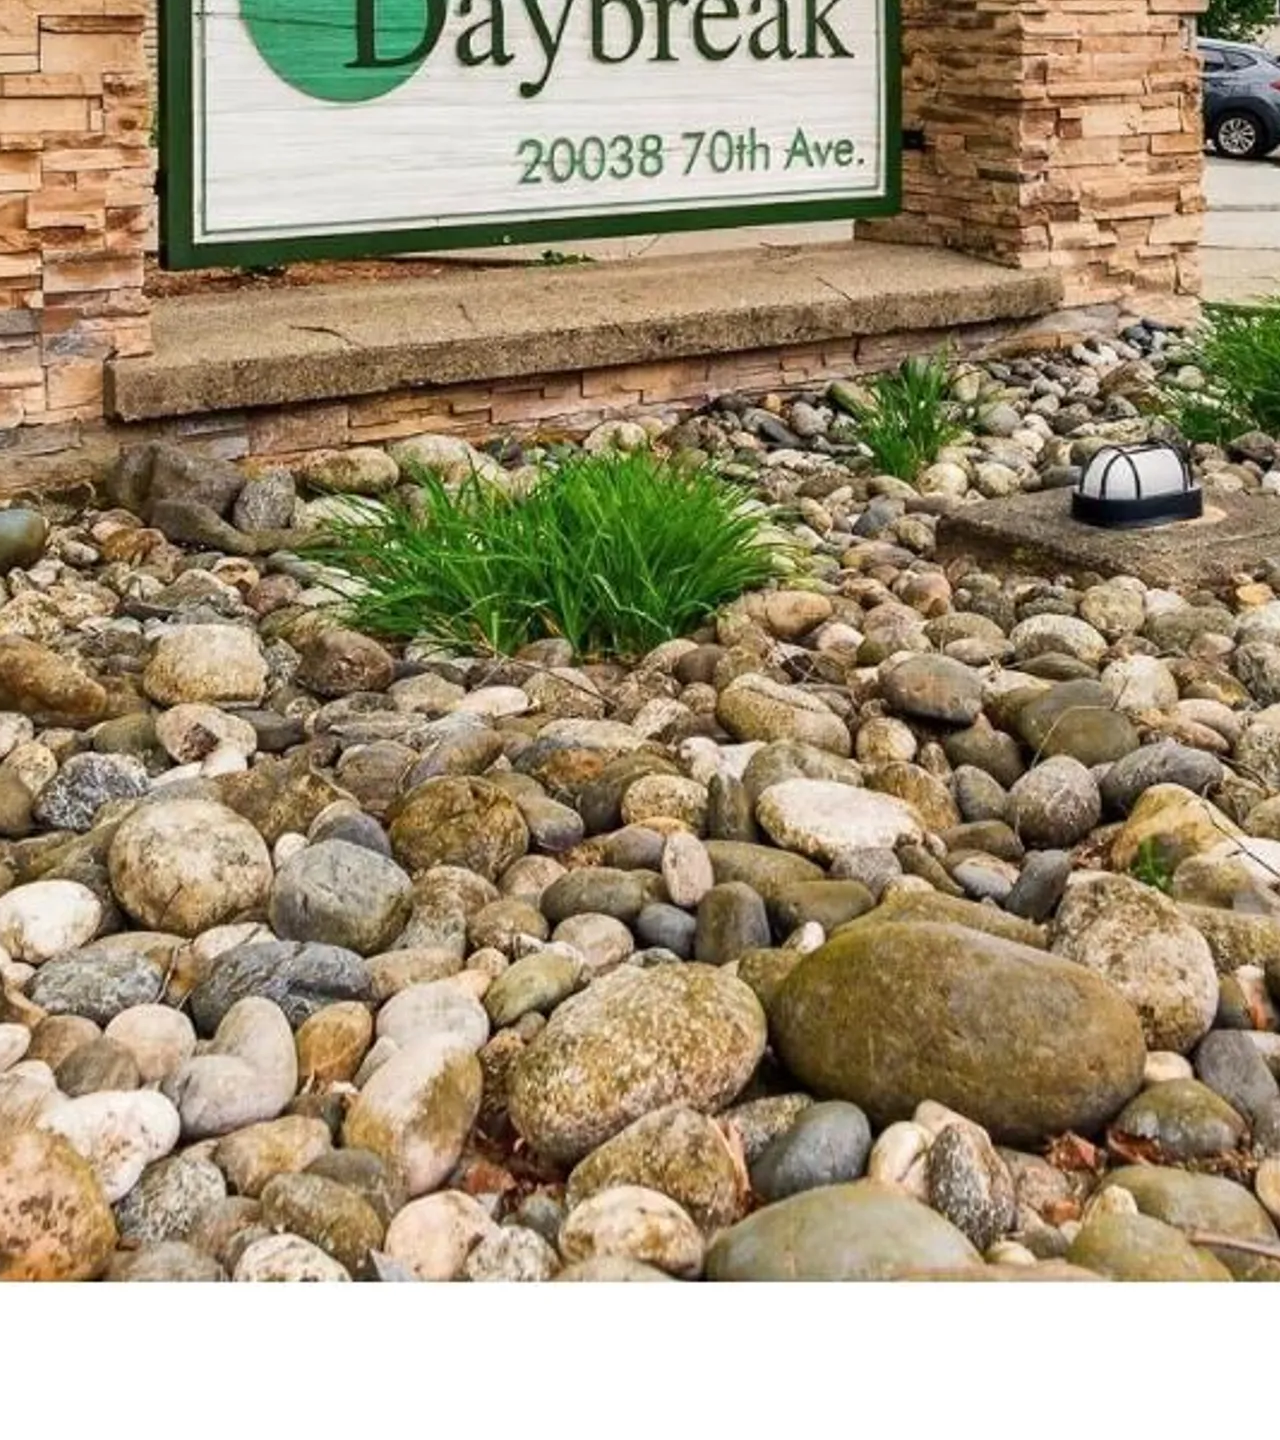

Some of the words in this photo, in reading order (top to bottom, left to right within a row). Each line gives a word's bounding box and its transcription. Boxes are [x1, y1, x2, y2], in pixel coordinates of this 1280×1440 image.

[518, 134, 663, 184] 20038
[682, 127, 770, 173] 70th
[784, 127, 865, 169] Ave.
